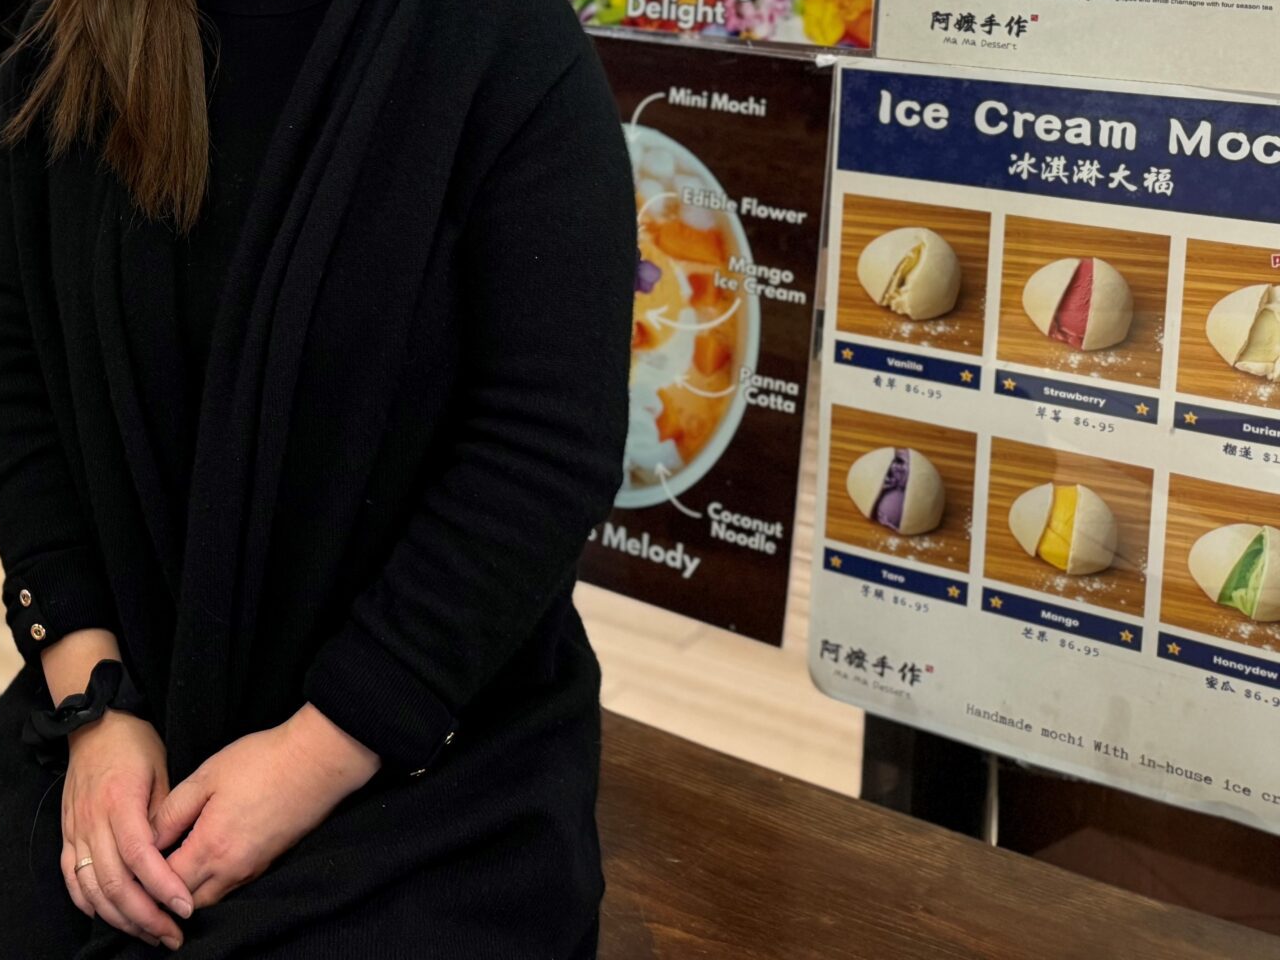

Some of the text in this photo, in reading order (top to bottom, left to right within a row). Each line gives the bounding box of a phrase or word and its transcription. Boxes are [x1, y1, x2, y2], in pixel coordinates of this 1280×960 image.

[981, 39, 1017, 50] Dessert
[669, 87, 766, 117] Mini Mochi
[878, 90, 949, 130] Ice
[974, 100, 1137, 151] Cream
[1008, 153, 1174, 196] 冰淇淋大福
[683, 188, 808, 224] Edible Flower
[728, 256, 794, 285] Mango
[713, 271, 806, 305] Ice Cream
[886, 357, 923, 372] Vanilla
[740, 367, 799, 396] Panna
[905, 383, 942, 400] $6.95
[744, 388, 796, 414] Cotta
[1043, 386, 1106, 408] Strawberry
[1074, 416, 1115, 432] $6.95
[707, 502, 783, 539] Coconut
[602, 522, 700, 578] Melody
[710, 522, 777, 555] Noodle
[881, 570, 905, 583] Taro
[893, 596, 929, 613] $6.95
[1041, 610, 1079, 627] Mango
[1059, 638, 1100, 657] $6.95
[1213, 655, 1278, 680] Honeydew
[966, 703, 1251, 796] Handmade mochi With in-house ice
